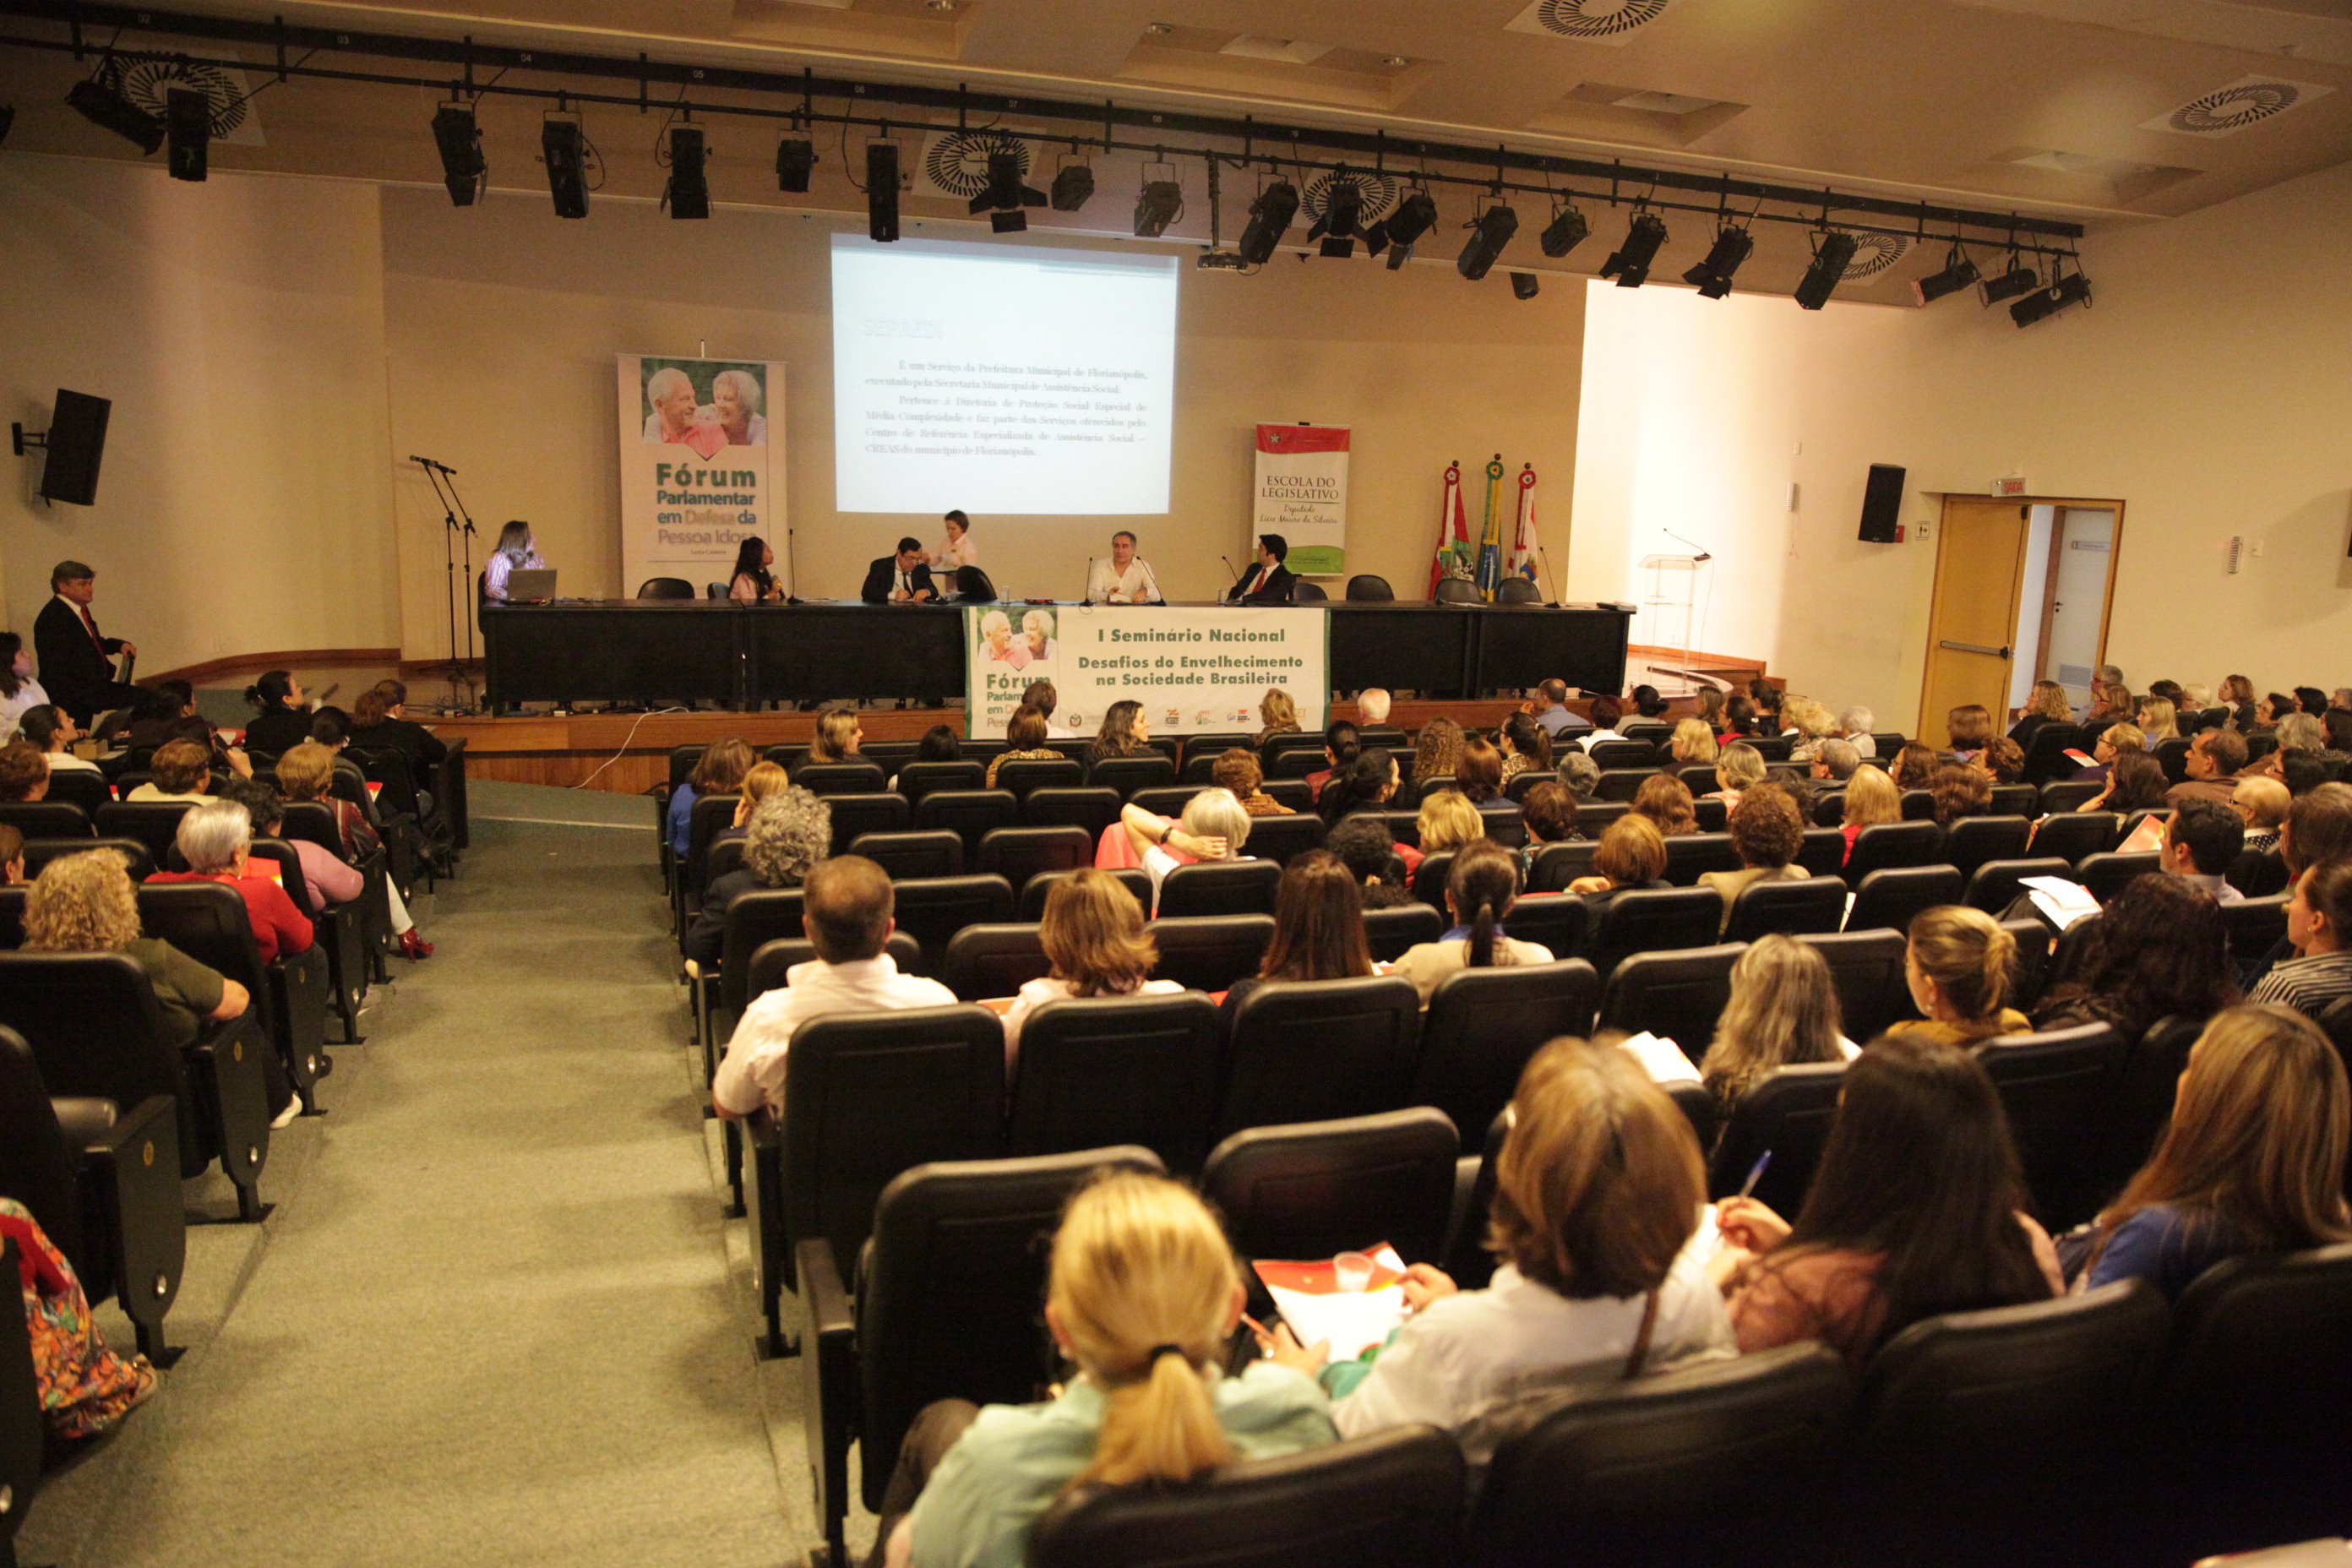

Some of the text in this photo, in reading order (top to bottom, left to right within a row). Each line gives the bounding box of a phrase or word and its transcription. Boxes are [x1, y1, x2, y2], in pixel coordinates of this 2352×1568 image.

[138, 14, 150, 24] 02
[337, 35, 349, 44] 03
[520, 53, 531, 63] 04
[693, 69, 704, 79] 05
[855, 85, 865, 94] 06
[1009, 100, 1018, 108] 07
[899, 359, 906, 369] É
[927, 362, 961, 373] Serviço
[964, 363, 975, 372] da
[978, 363, 1023, 373] Prefeitura
[1027, 366, 1070, 378] Municipal
[1074, 368, 1085, 376] de
[865, 377, 912, 385] executado
[913, 378, 932, 389] pela
[934, 379, 980, 388] Secretaria
[983, 380, 1027, 392] Municipal
[1042, 383, 1090, 392] Assistência
[899, 395, 939, 405] Pertence
[956, 397, 997, 406] Diretoria
[1002, 398, 1014, 407] de
[1019, 400, 1058, 411] Proteção
[1063, 400, 1089, 410] Social
[1095, 402, 1130, 413] Especial
[1135, 403, 1146, 411] de
[865, 411, 895, 421] Média
[899, 411, 963, 423] Complexidade
[976, 413, 990, 422] faz
[994, 416, 1017, 425] parte
[1021, 415, 1036, 424] dos
[1039, 416, 1076, 427] Serviços
[1080, 417, 1124, 427] oferecidos
[1128, 417, 1146, 429] pelo
[865, 427, 897, 437] Centro
[902, 428, 914, 438] de
[920, 429, 967, 438] Referência
[973, 430, 1032, 442] Especializada
[1038, 431, 1049, 440] de
[1054, 432, 1102, 442] Assistência
[1108, 433, 1134, 443] Social
[865, 444, 899, 454] CREAS
[900, 444, 912, 454] do
[962, 445, 973, 455] de
[656, 462, 756, 487] Fórum
[1267, 476, 1336, 487] ESCOLA DO
[656, 490, 755, 506] Parlamentar
[1262, 487, 1339, 500] LEGISLATIVO
[657, 509, 757, 525] em Defesa da
[658, 529, 712, 544] Pessoa
[1098, 628, 1285, 642] I Seminário Nacional
[1078, 655, 1304, 669] Desafios do Envelhecimento
[1096, 672, 1288, 686] na Sociedade Brasileira
[987, 691, 1023, 701] Parlam
[987, 705, 1003, 715] em
[987, 717, 1010, 727] Pess
